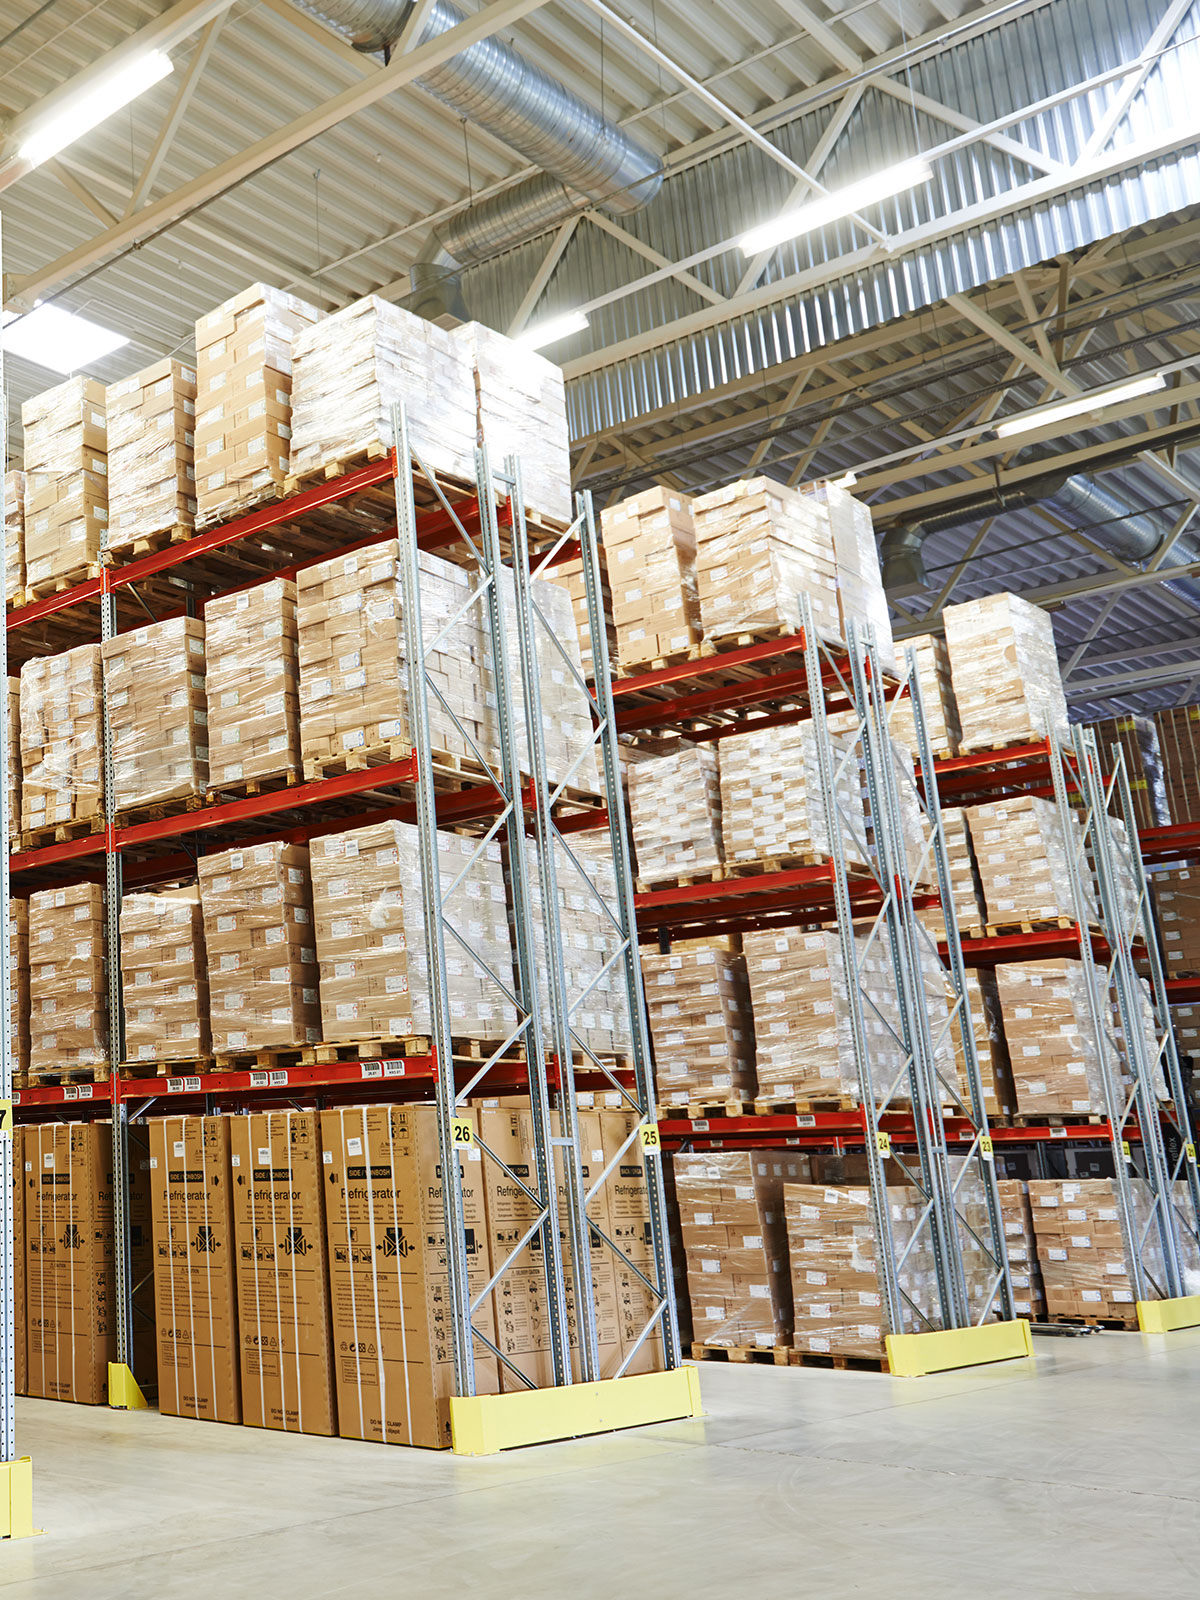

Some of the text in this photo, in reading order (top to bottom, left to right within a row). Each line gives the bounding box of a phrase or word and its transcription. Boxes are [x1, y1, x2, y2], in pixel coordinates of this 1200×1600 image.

[454, 1125, 470, 1141] 26
[643, 1131, 657, 1145] 25
[879, 1138, 888, 1150] 24
[982, 1141, 991, 1152] 23
[349, 1169, 361, 1177] SIDE
[247, 1189, 301, 1202] Refrigeraor
